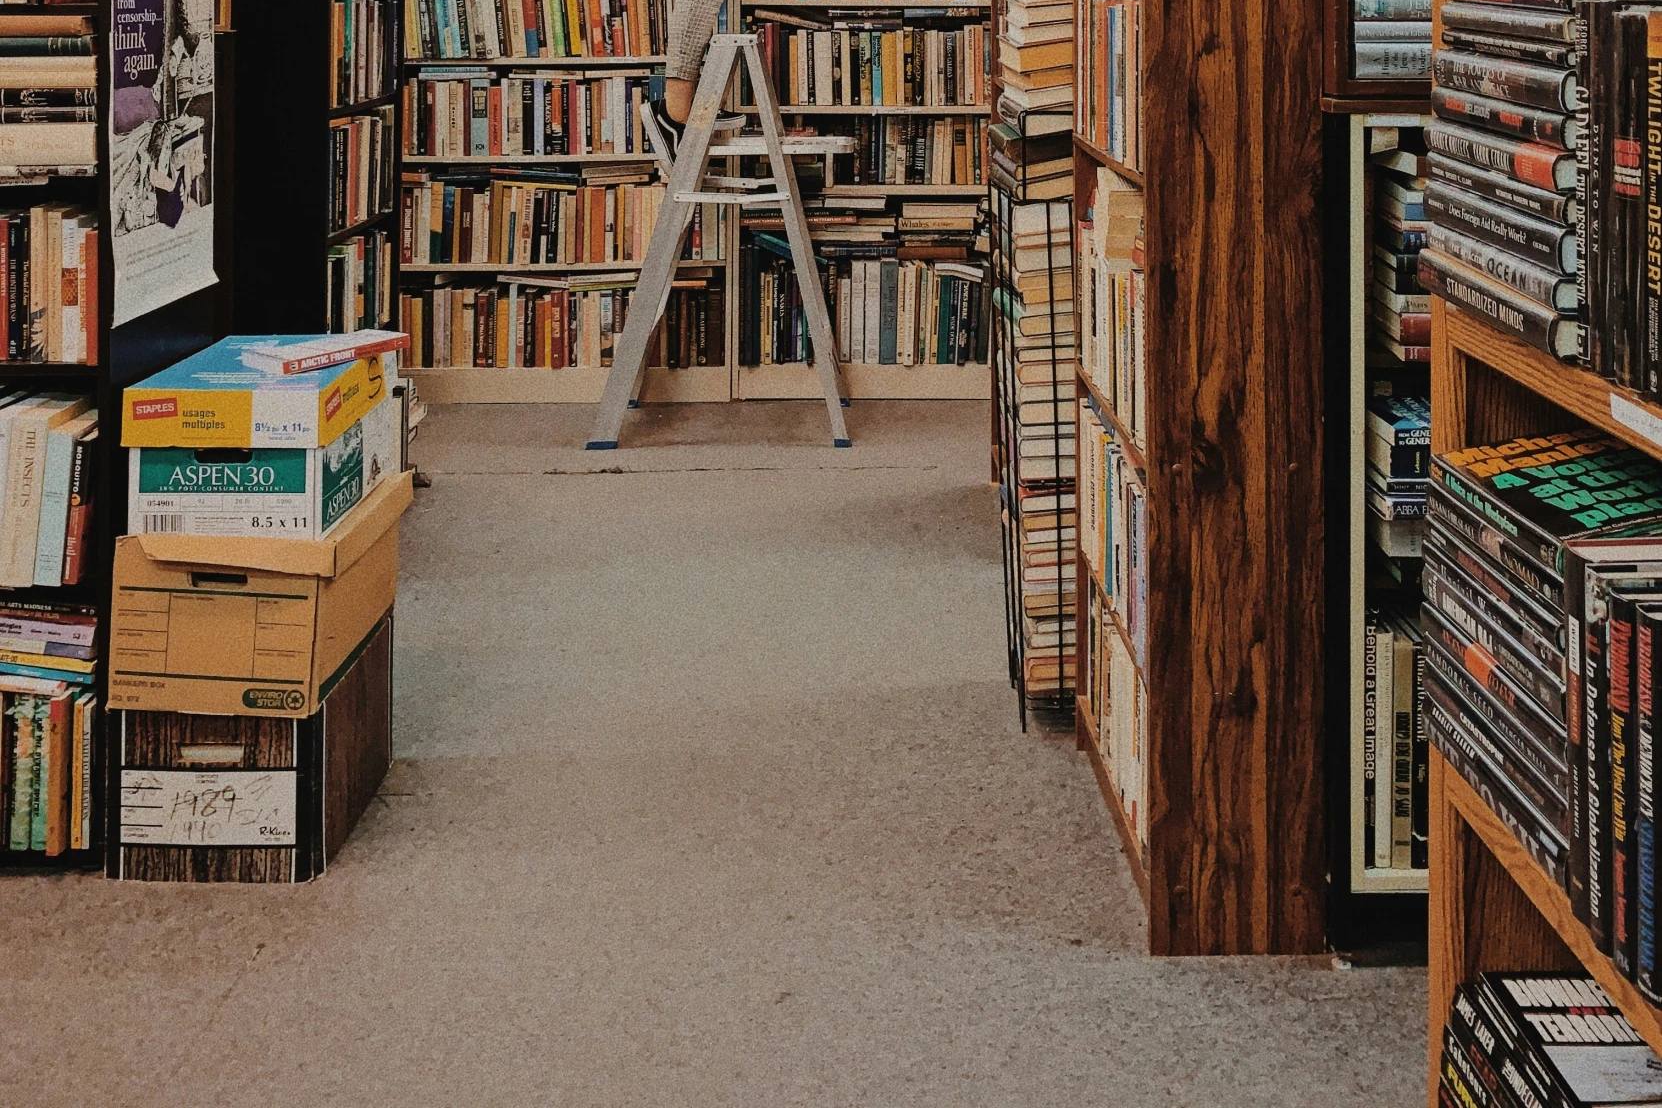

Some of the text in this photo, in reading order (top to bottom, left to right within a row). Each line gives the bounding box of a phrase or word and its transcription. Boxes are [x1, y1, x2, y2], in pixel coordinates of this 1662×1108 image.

[114, 23, 146, 51] think
[1580, 20, 1588, 57] GEORGE
[124, 49, 158, 80] again.
[1453, 61, 1509, 81] THE POWERS OF
[1647, 62, 1662, 176] TWILIGHT
[1576, 173, 1586, 200] THE
[1650, 172, 1657, 182] IN
[1593, 189, 1599, 209] TO
[1449, 202, 1527, 244] Does Foreign Aid Really Work?
[1576, 206, 1586, 254] DESERT
[1647, 204, 1662, 295] DESERT
[1487, 258, 1527, 288] OCEAN
[1576, 256, 1586, 304] MYSTIC
[1446, 278, 1524, 332] STANDARDIZED MINDS
[300, 348, 356, 370] ARCTIC FRONT
[135, 403, 175, 415] STAPLES
[182, 409, 216, 420] usages
[325, 394, 341, 416] STAPLES
[182, 419, 226, 430] multiples
[291, 423, 302, 432] 11
[21, 429, 36, 508] THE INSECTS
[72, 446, 83, 492] MOSQUITO
[168, 465, 275, 486] ASPEN 30
[1492, 472, 1530, 490] A
[327, 477, 359, 521] ASPEN 30
[1446, 471, 1518, 540] A Voice at the Workplace
[1529, 478, 1579, 498] at
[252, 516, 273, 528] 8.5
[279, 518, 286, 527] x
[293, 516, 307, 528] 11
[1394, 505, 1419, 515] ABBA
[1503, 550, 1540, 590] NOMAD
[1442, 590, 1476, 639] AMERICAN
[1427, 642, 1469, 695] PANDORA'S
[1473, 688, 1493, 720] SEED
[256, 698, 280, 707] STOR
[1365, 626, 1376, 779] Behold a Great Image
[1459, 709, 1504, 766] CATASTROPHE
[1610, 618, 1632, 842] TERRORISM How The West Can Win
[1638, 626, 1654, 823] TERRORISM DEMOCRACY
[170, 785, 243, 822] 1989
[1586, 659, 1602, 918] In Defense of Globalization
[1456, 993, 1495, 1055] JAMES LAXER
[1449, 1037, 1486, 1105] Saboteurs
